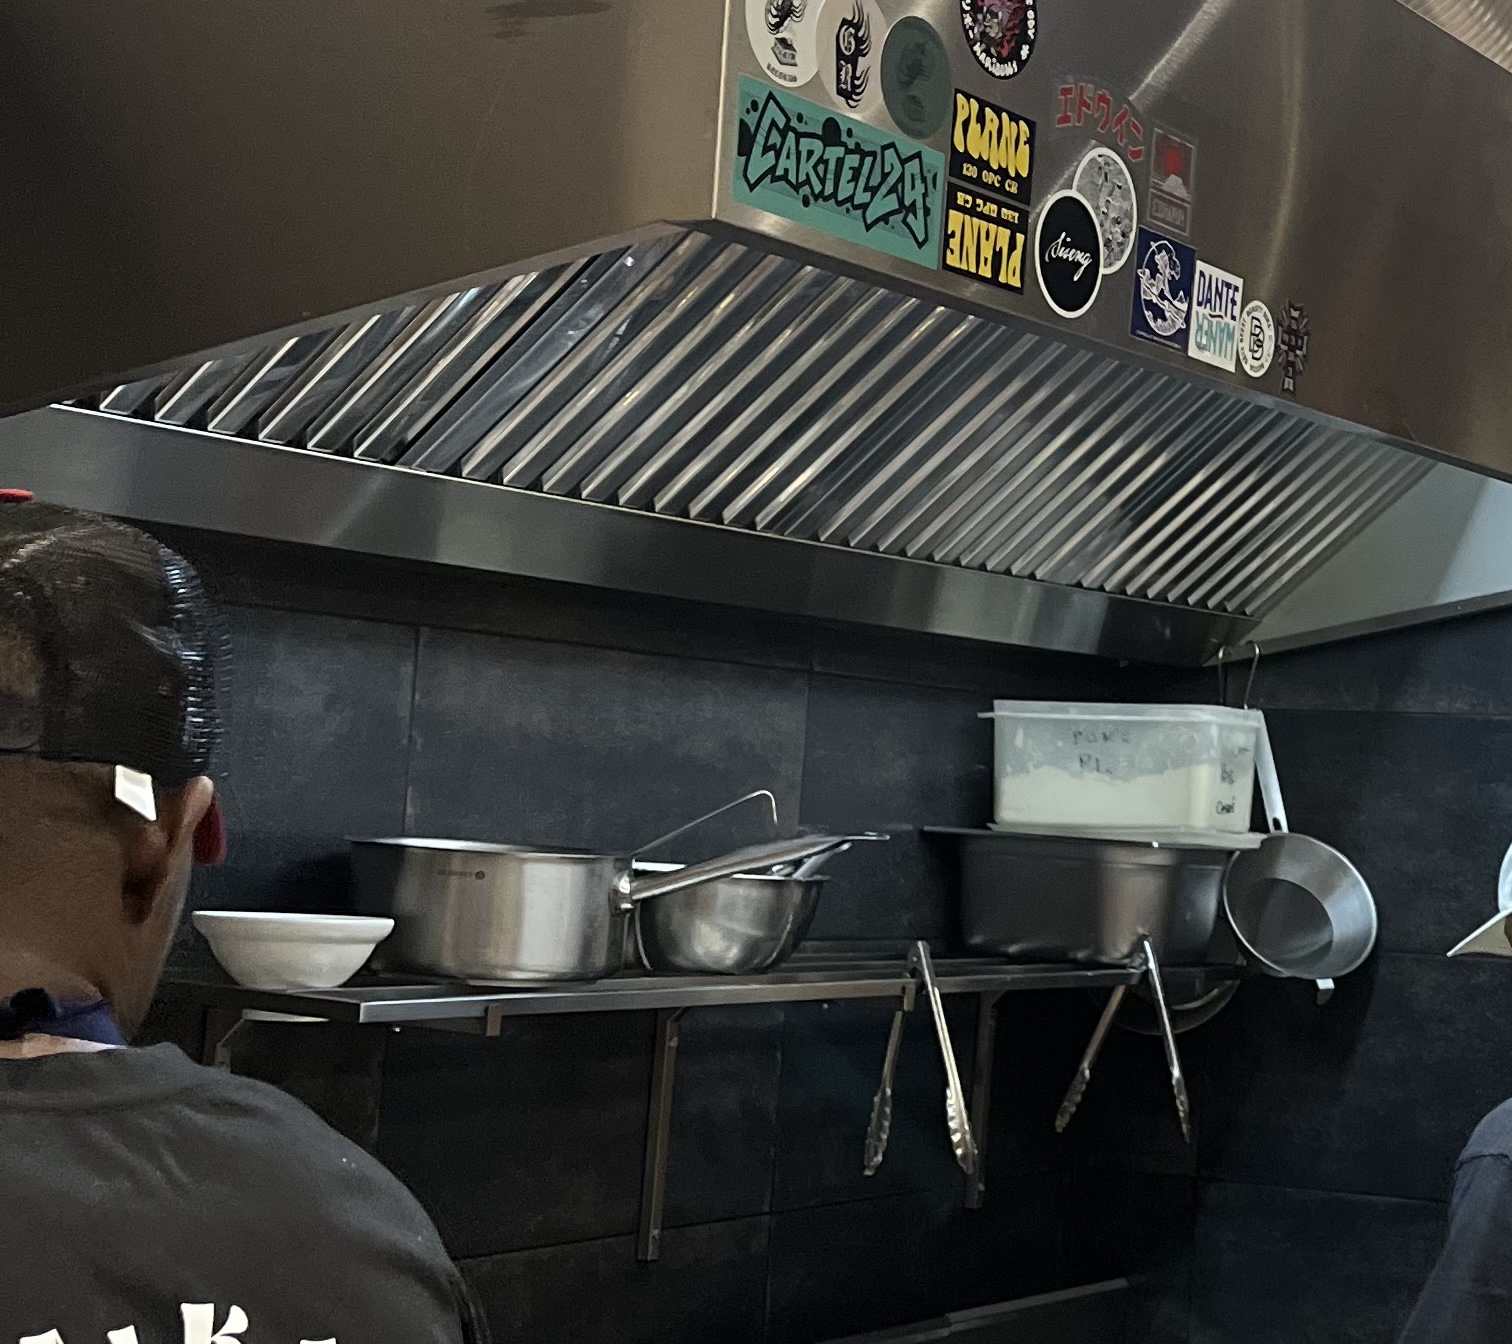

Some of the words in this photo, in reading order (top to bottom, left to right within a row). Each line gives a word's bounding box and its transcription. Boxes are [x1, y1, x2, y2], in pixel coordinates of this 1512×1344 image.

[953, 92, 1030, 178] PLANE
[981, 169, 1002, 188] OPC
[945, 208, 1026, 288] PLANE
[1196, 269, 1240, 322] DANTE
